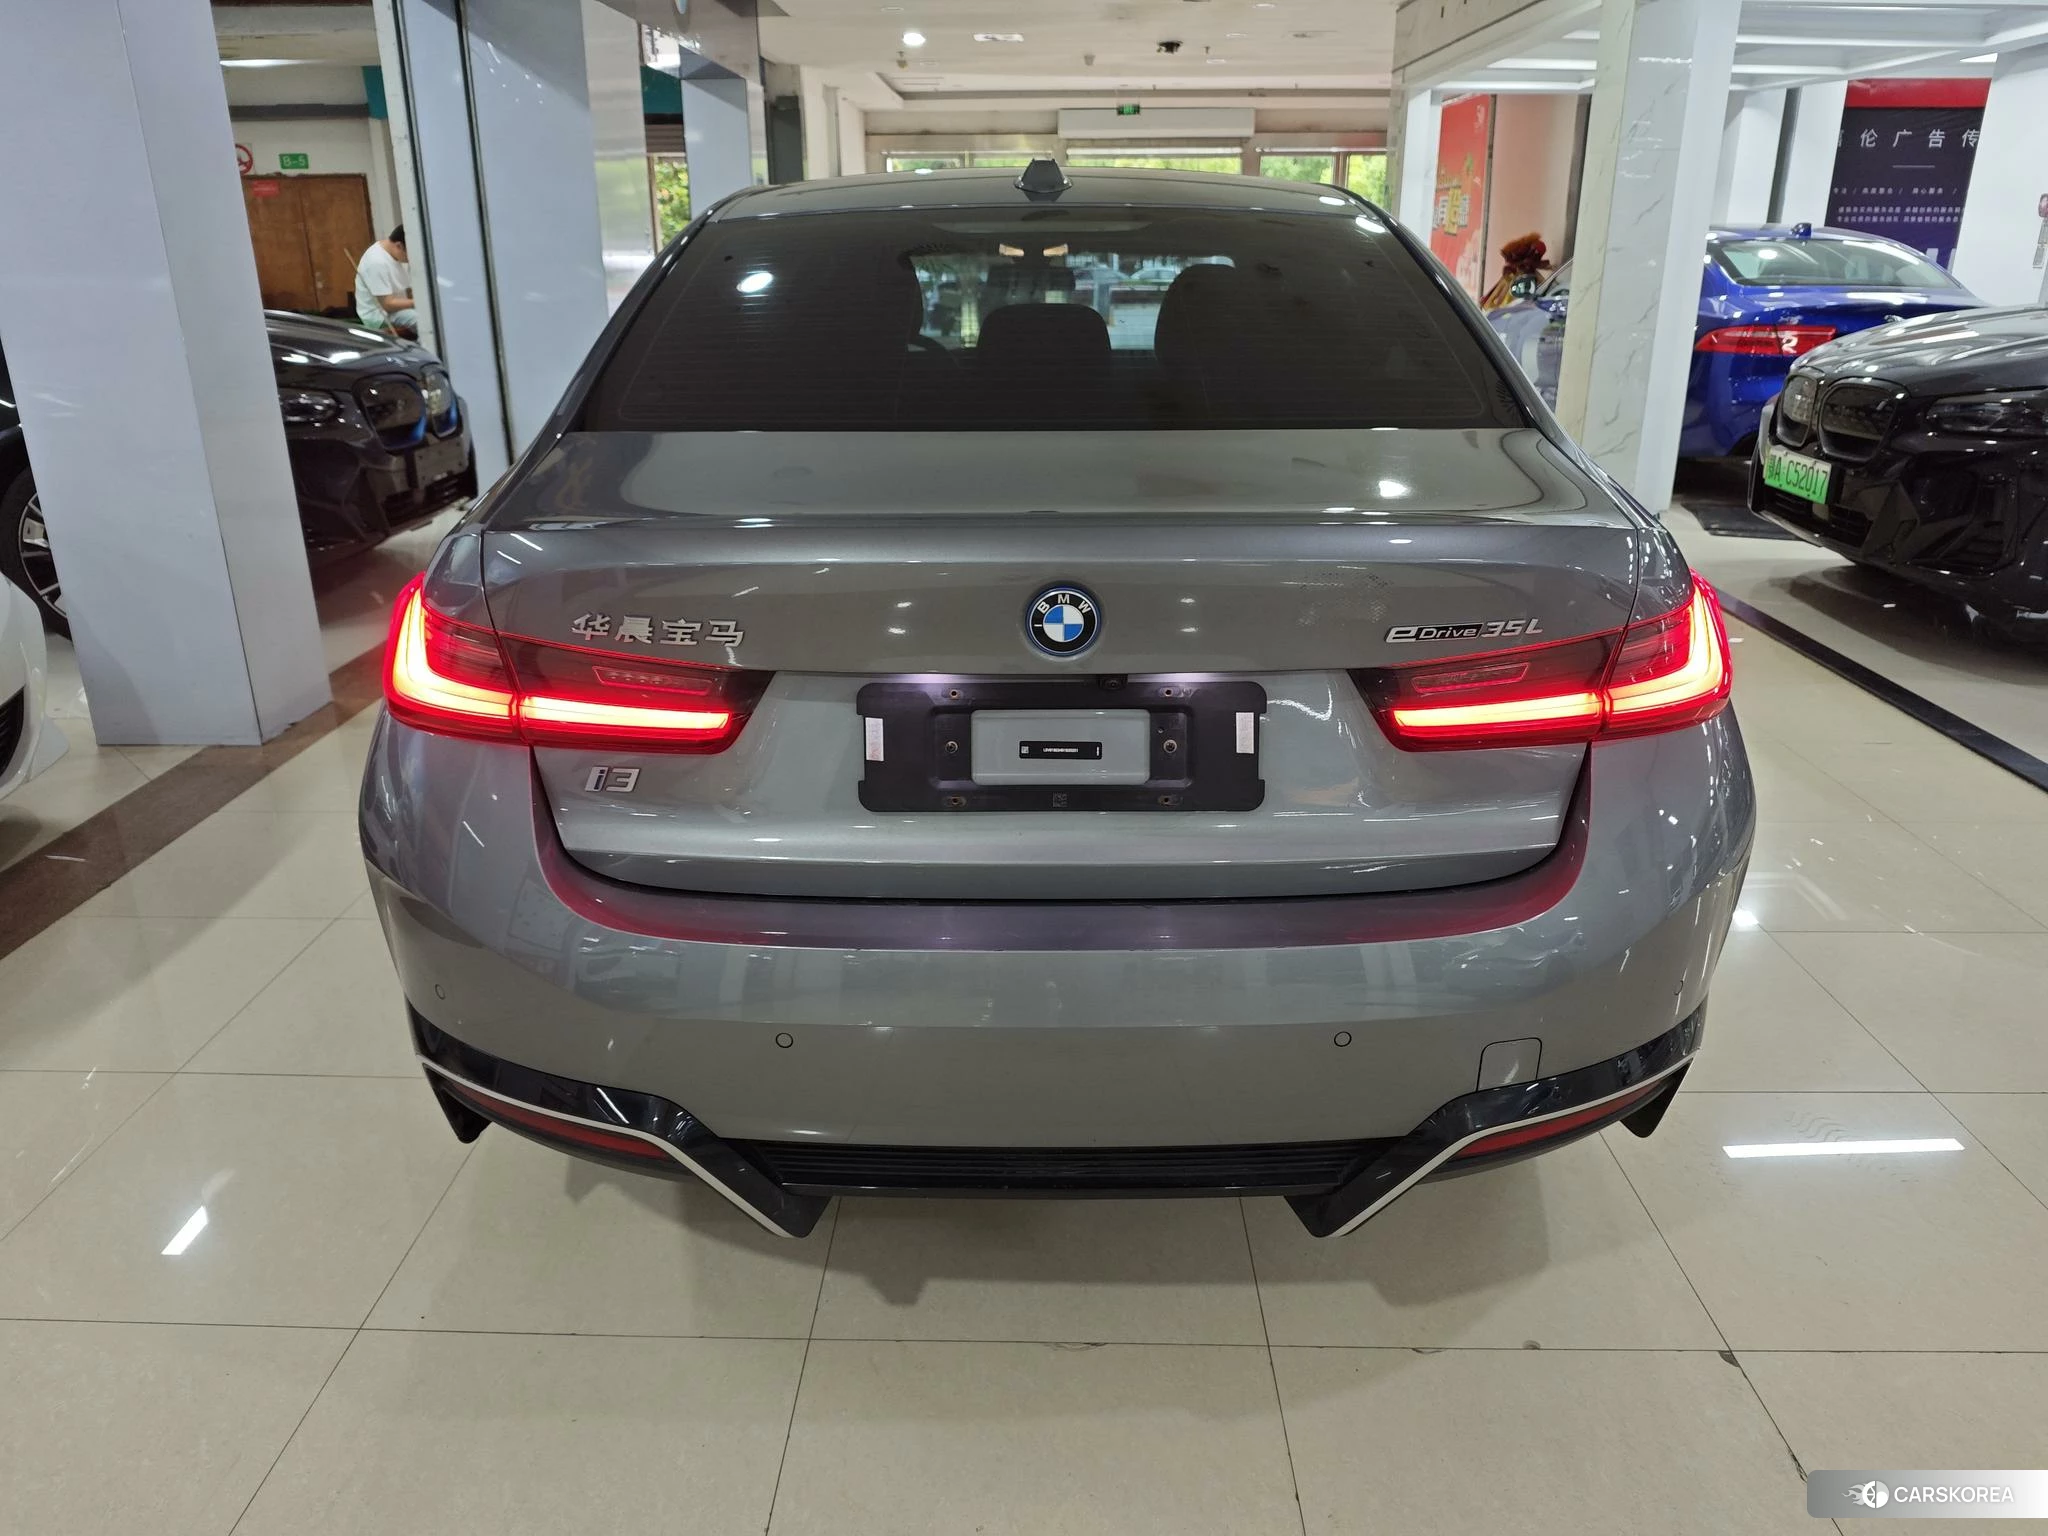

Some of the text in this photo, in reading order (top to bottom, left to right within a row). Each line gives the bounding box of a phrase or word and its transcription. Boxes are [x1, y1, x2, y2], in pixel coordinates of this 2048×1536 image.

[1786, 460, 1829, 498] C52017
[1037, 593, 1092, 615] BMW
[571, 613, 745, 648] 华晨宝马
[584, 765, 641, 793] i3
